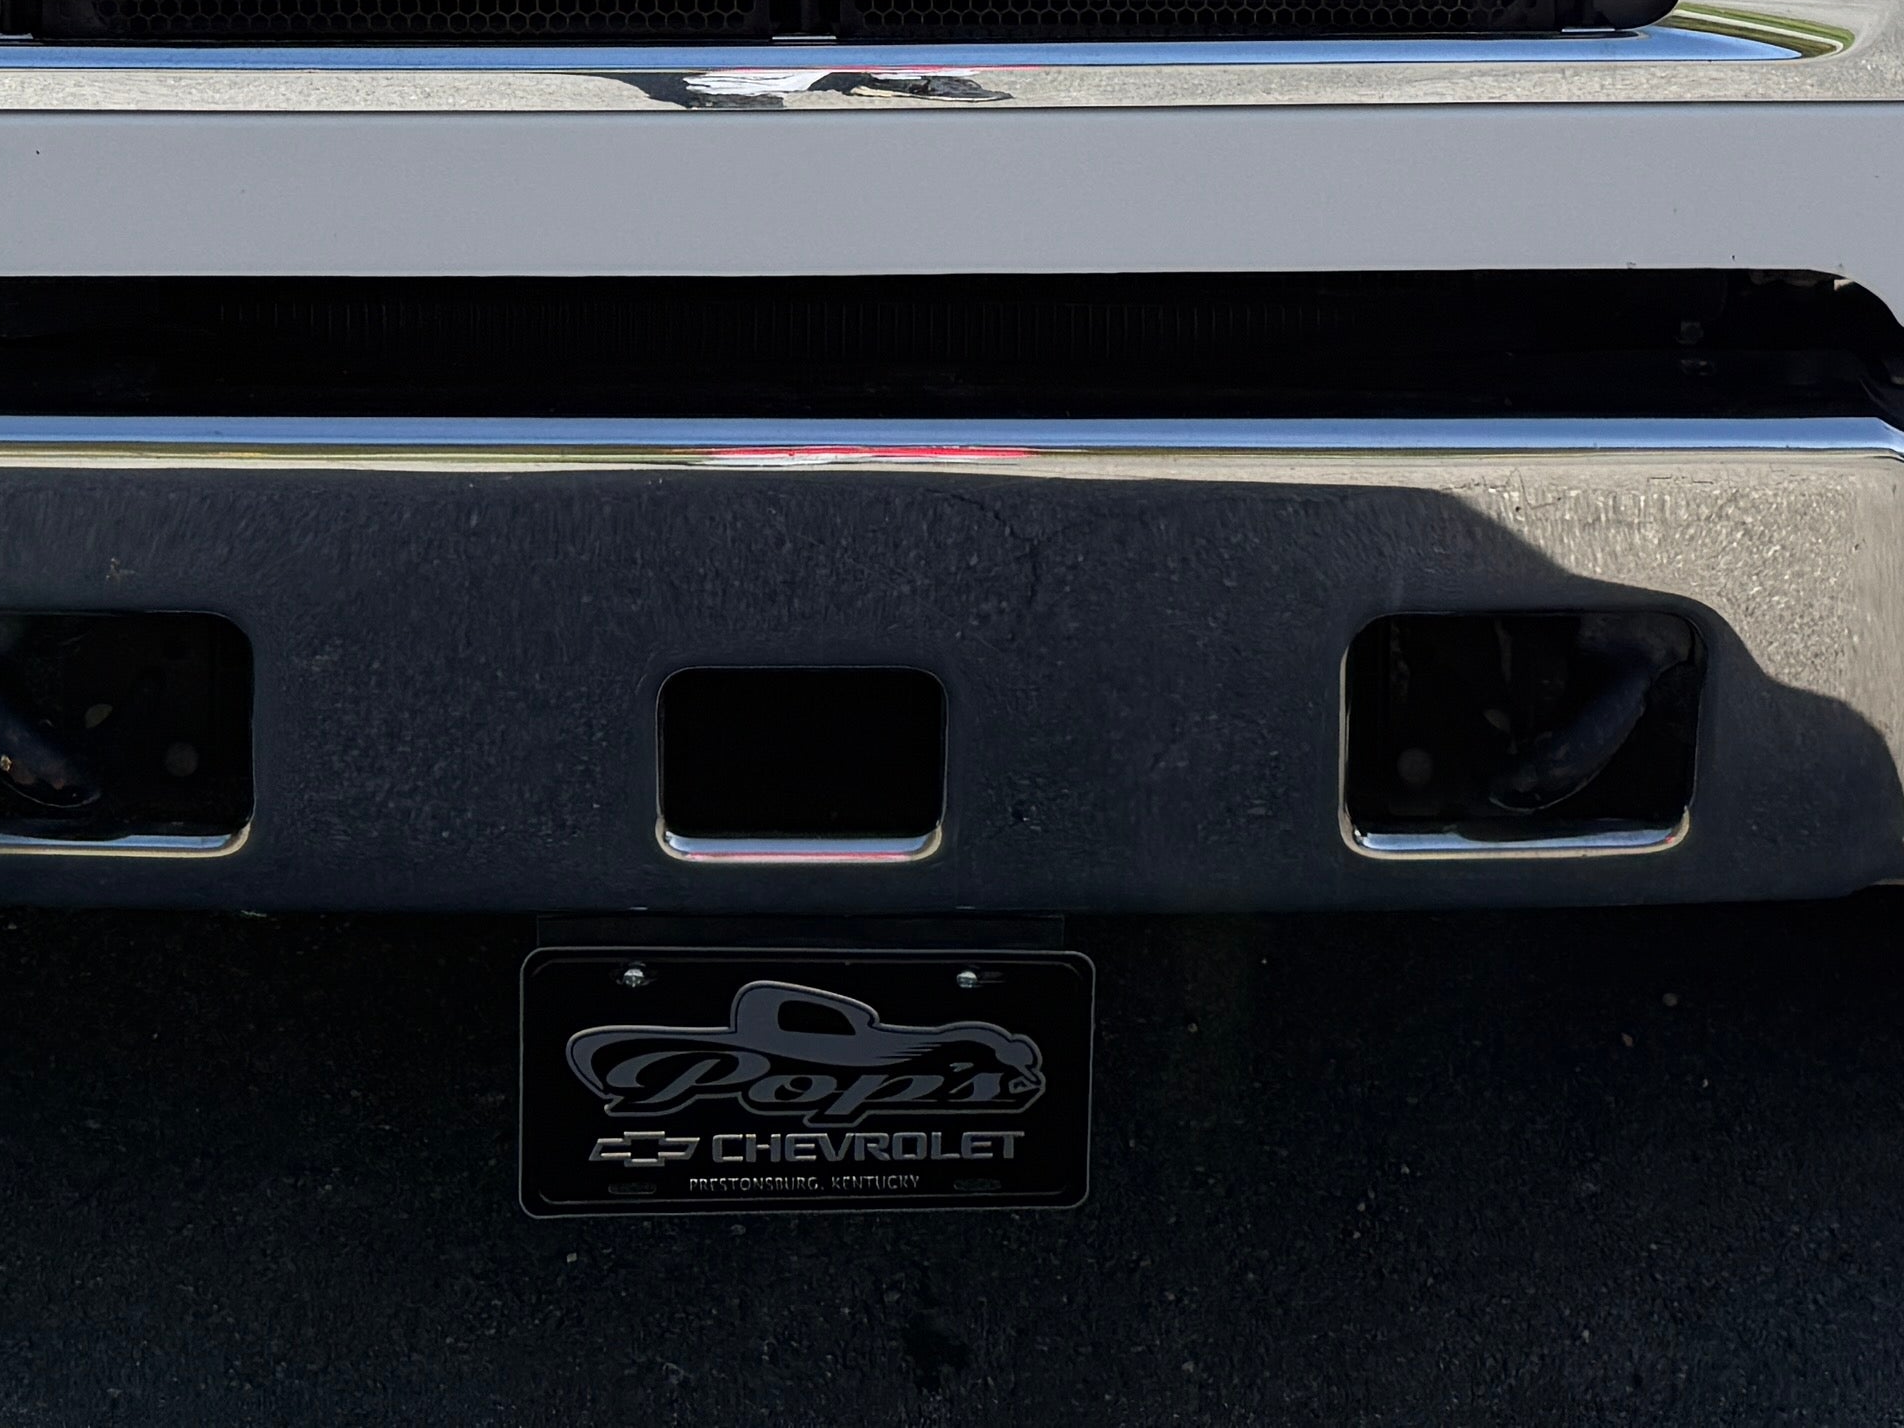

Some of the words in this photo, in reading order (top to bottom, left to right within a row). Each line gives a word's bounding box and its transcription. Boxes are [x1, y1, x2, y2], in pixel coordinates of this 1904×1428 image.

[605, 1050, 1005, 1116] Pop's
[712, 1131, 1025, 1163] CHEVROLET
[831, 1175, 920, 1190] KENTUCKY
